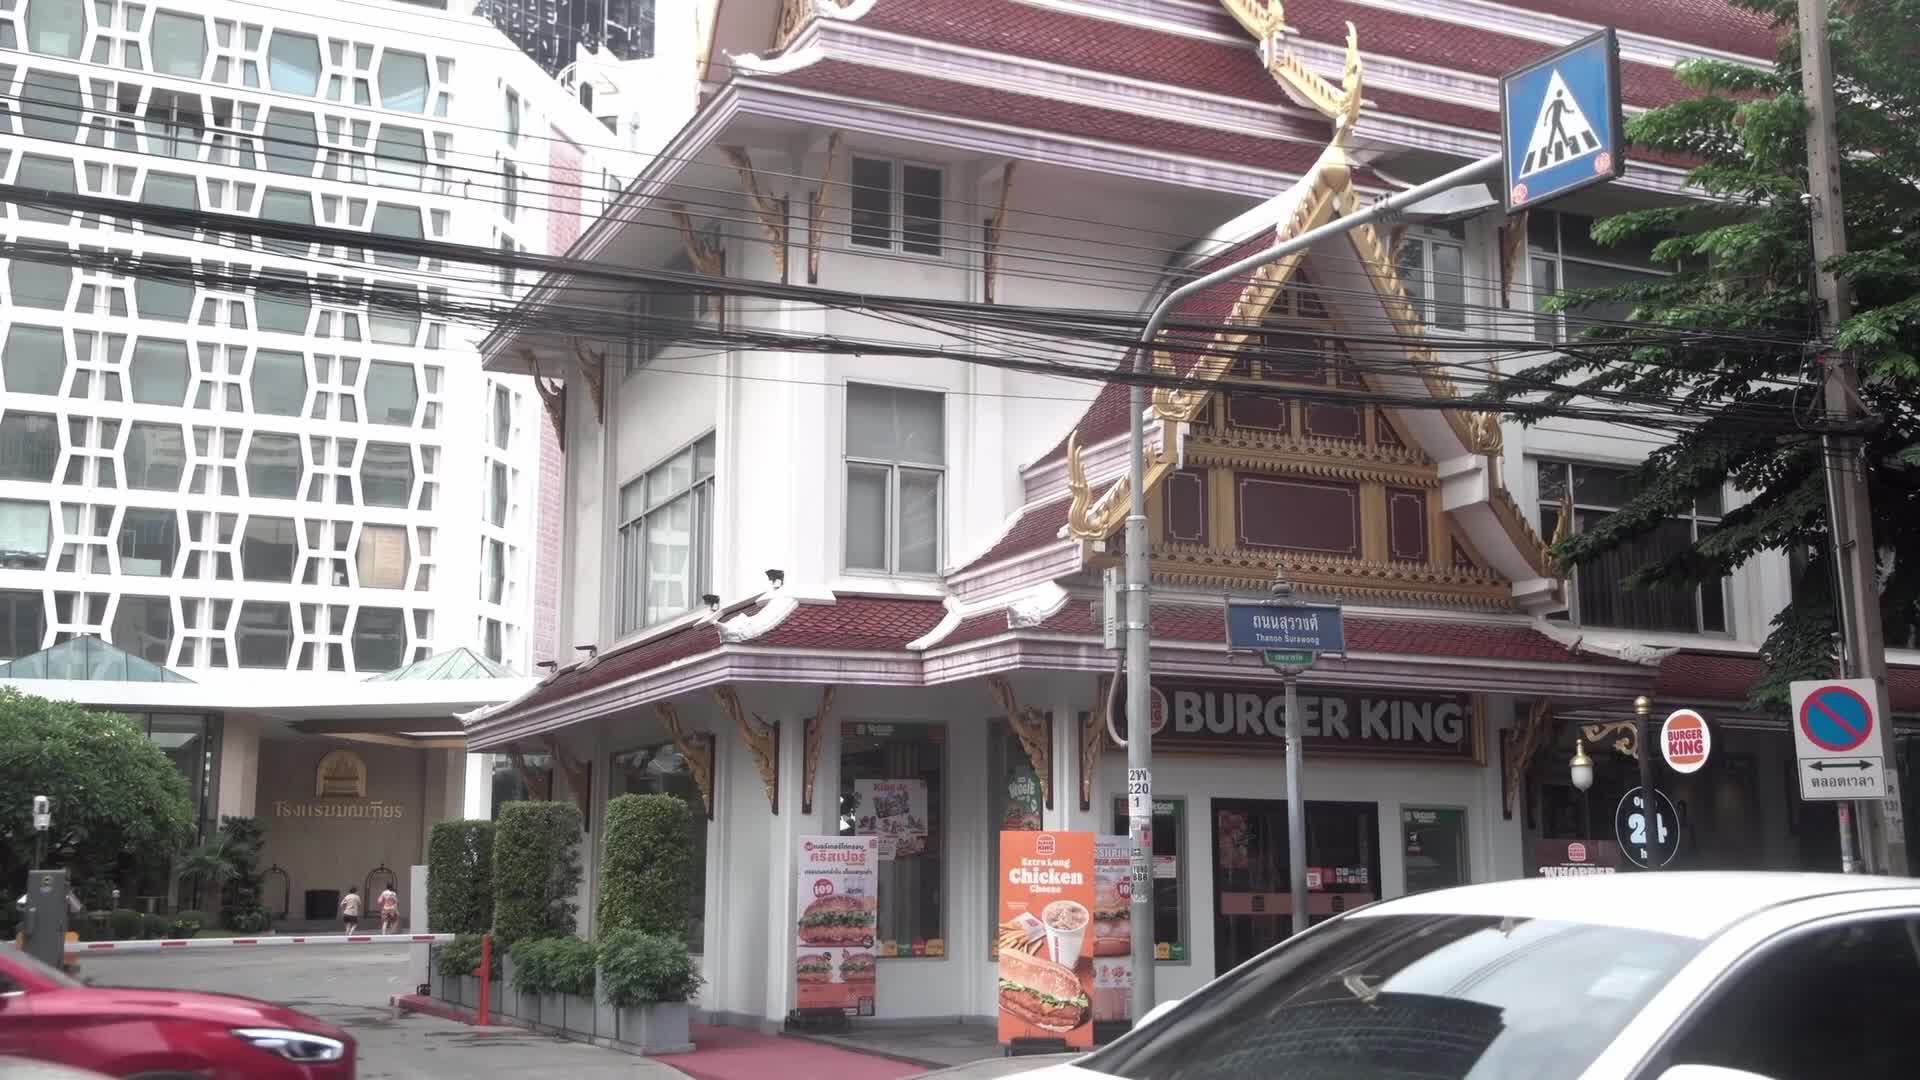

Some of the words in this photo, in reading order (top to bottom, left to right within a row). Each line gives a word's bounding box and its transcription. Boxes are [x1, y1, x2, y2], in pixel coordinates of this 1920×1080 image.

[1253, 613, 1319, 633] ถนนสุรวงศ์
[1256, 633, 1282, 642] Thanon
[1284, 635, 1320, 645] Surawong
[1174, 691, 1349, 739] BURGER
[1360, 699, 1464, 743] KING
[1667, 729, 1703, 741] BURGER
[1668, 740, 1704, 755] KING
[1811, 776, 1875, 788] ตลอดเวลา
[1128, 783, 1149, 794] 220
[1133, 797, 1140, 808] 1
[1022, 858, 1046, 866] Extra
[1047, 858, 1071, 869] Long
[1009, 868, 1084, 885] Chicken
[1030, 885, 1062, 893] Cheese
